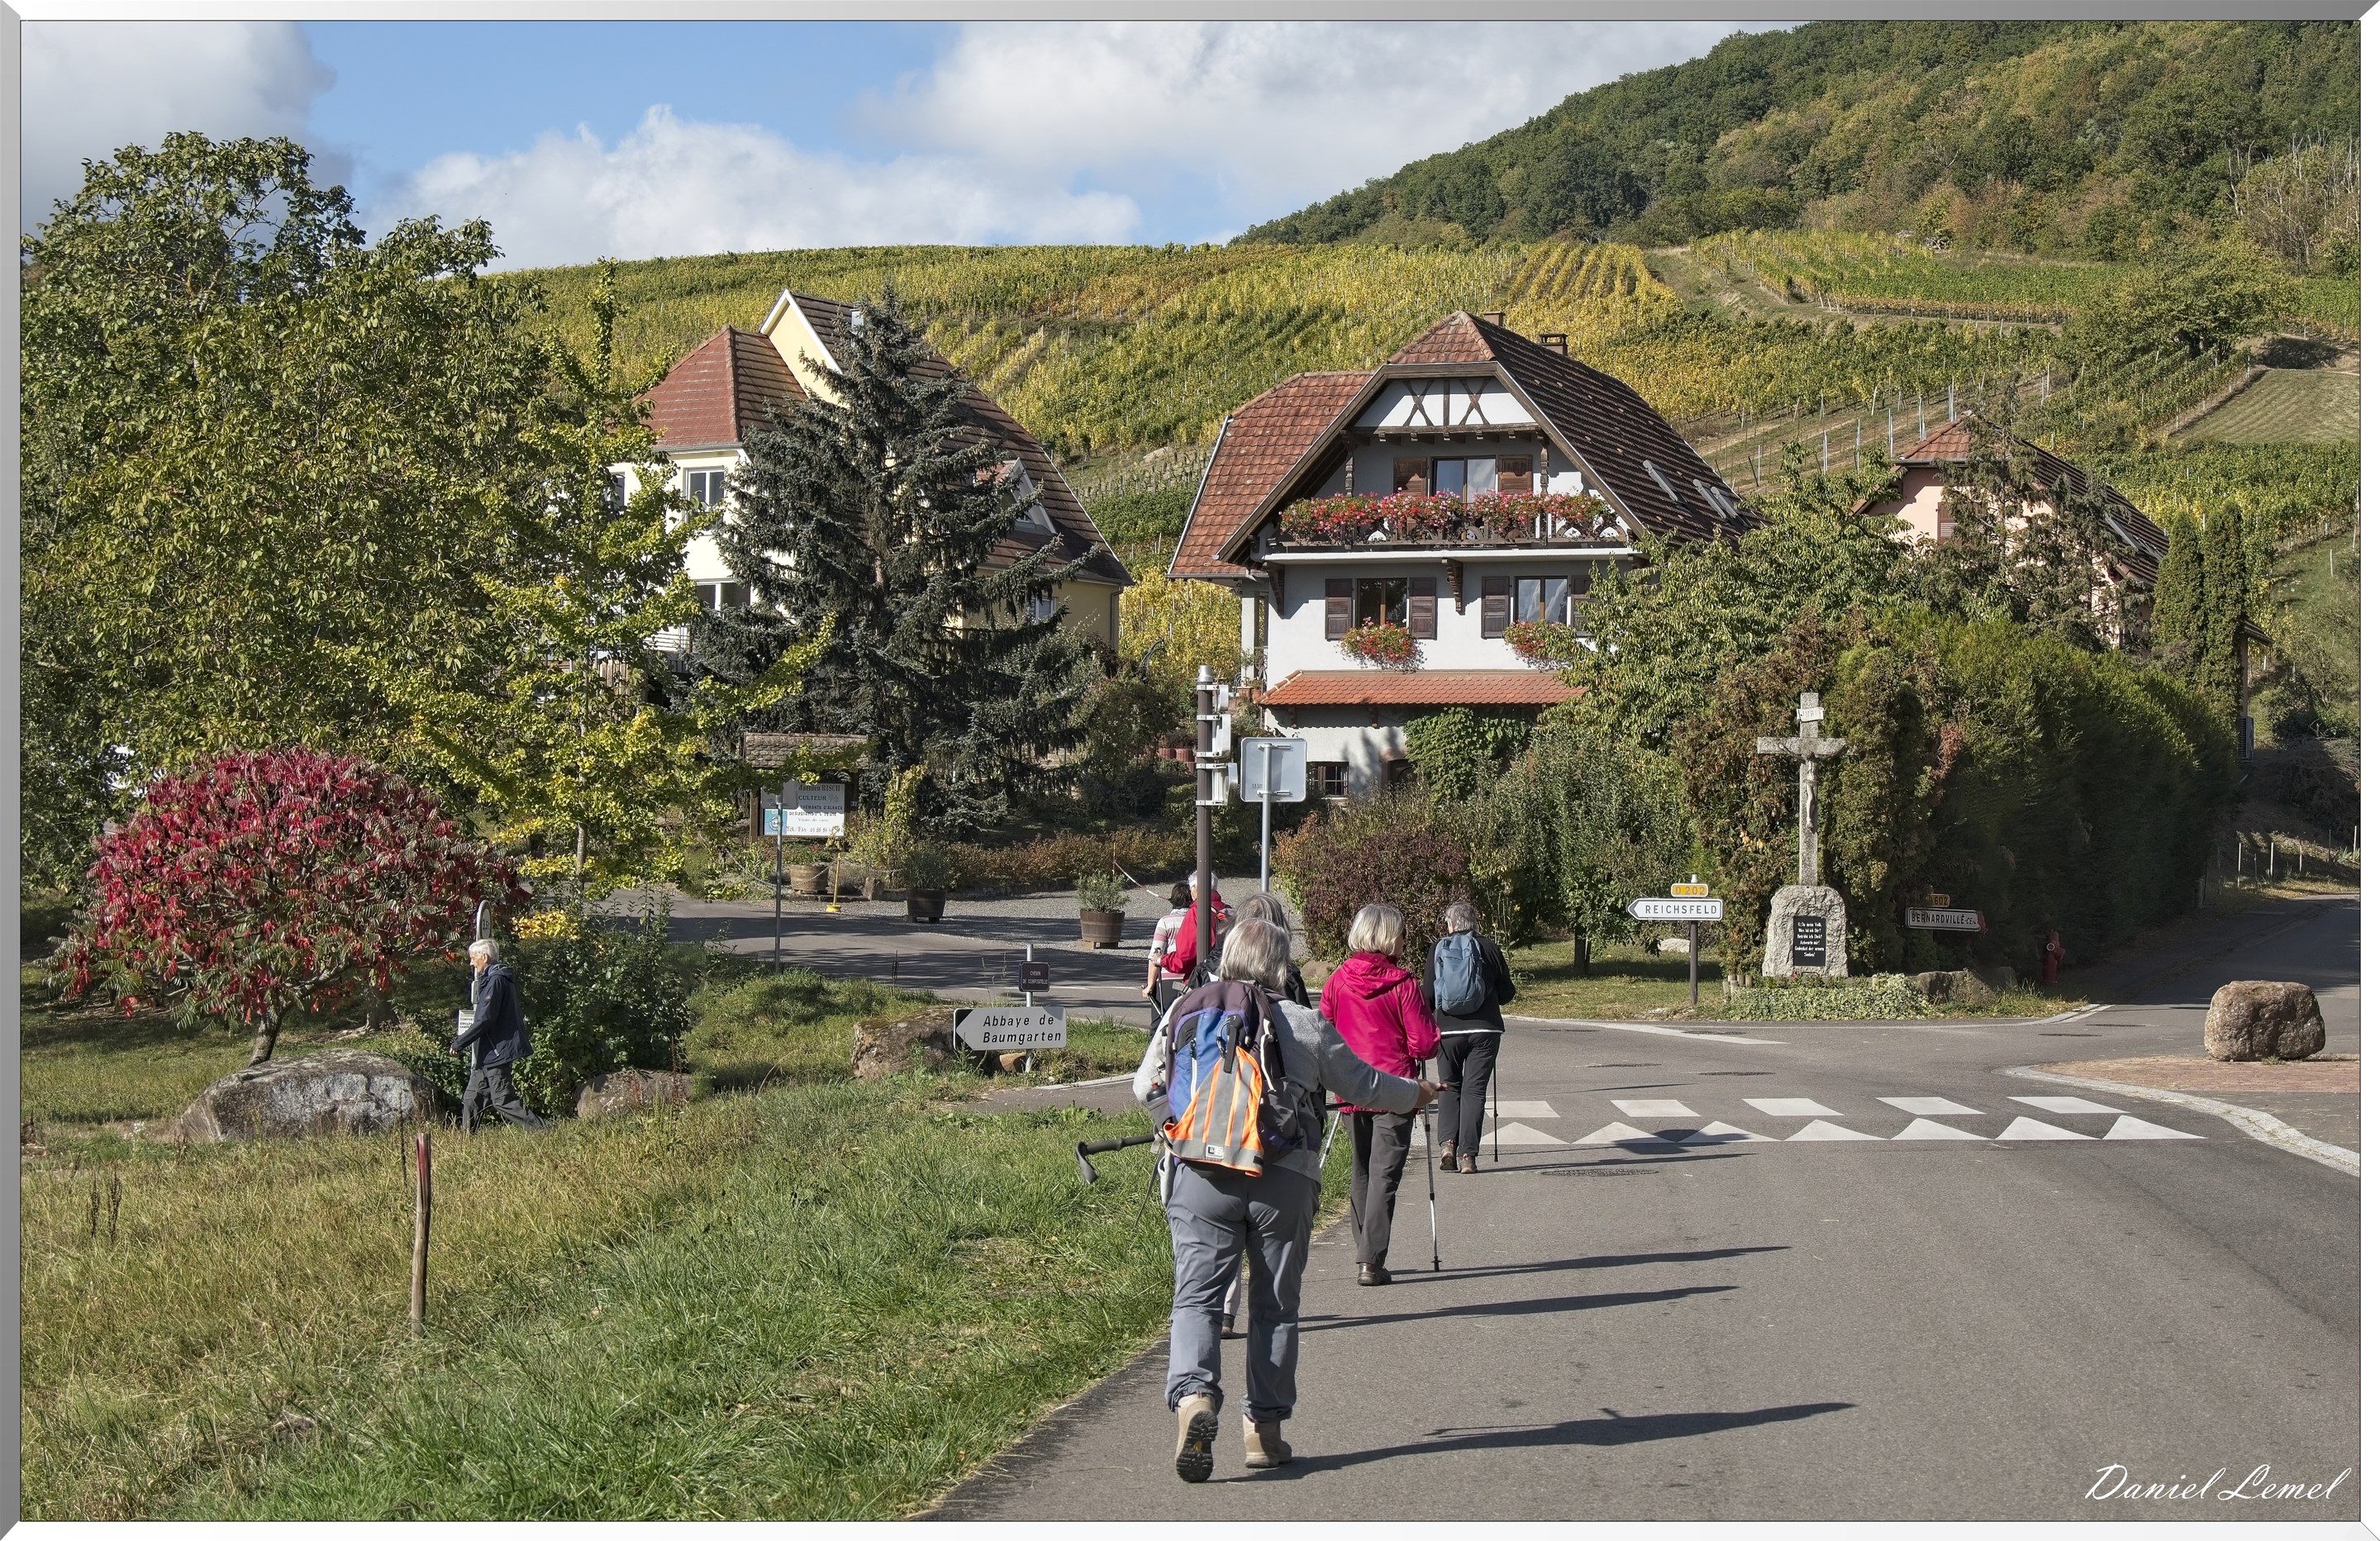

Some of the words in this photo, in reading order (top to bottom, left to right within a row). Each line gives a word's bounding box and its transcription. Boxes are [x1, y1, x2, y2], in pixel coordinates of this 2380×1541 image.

[1686, 886, 1706, 895] 202
[1935, 896, 1948, 905] 602
[1645, 905, 1717, 915] REICHSFELD
[983, 1015, 1030, 1027] Abbaye
[1039, 1015, 1054, 1025] de
[983, 1032, 1061, 1045] Baumgarten
